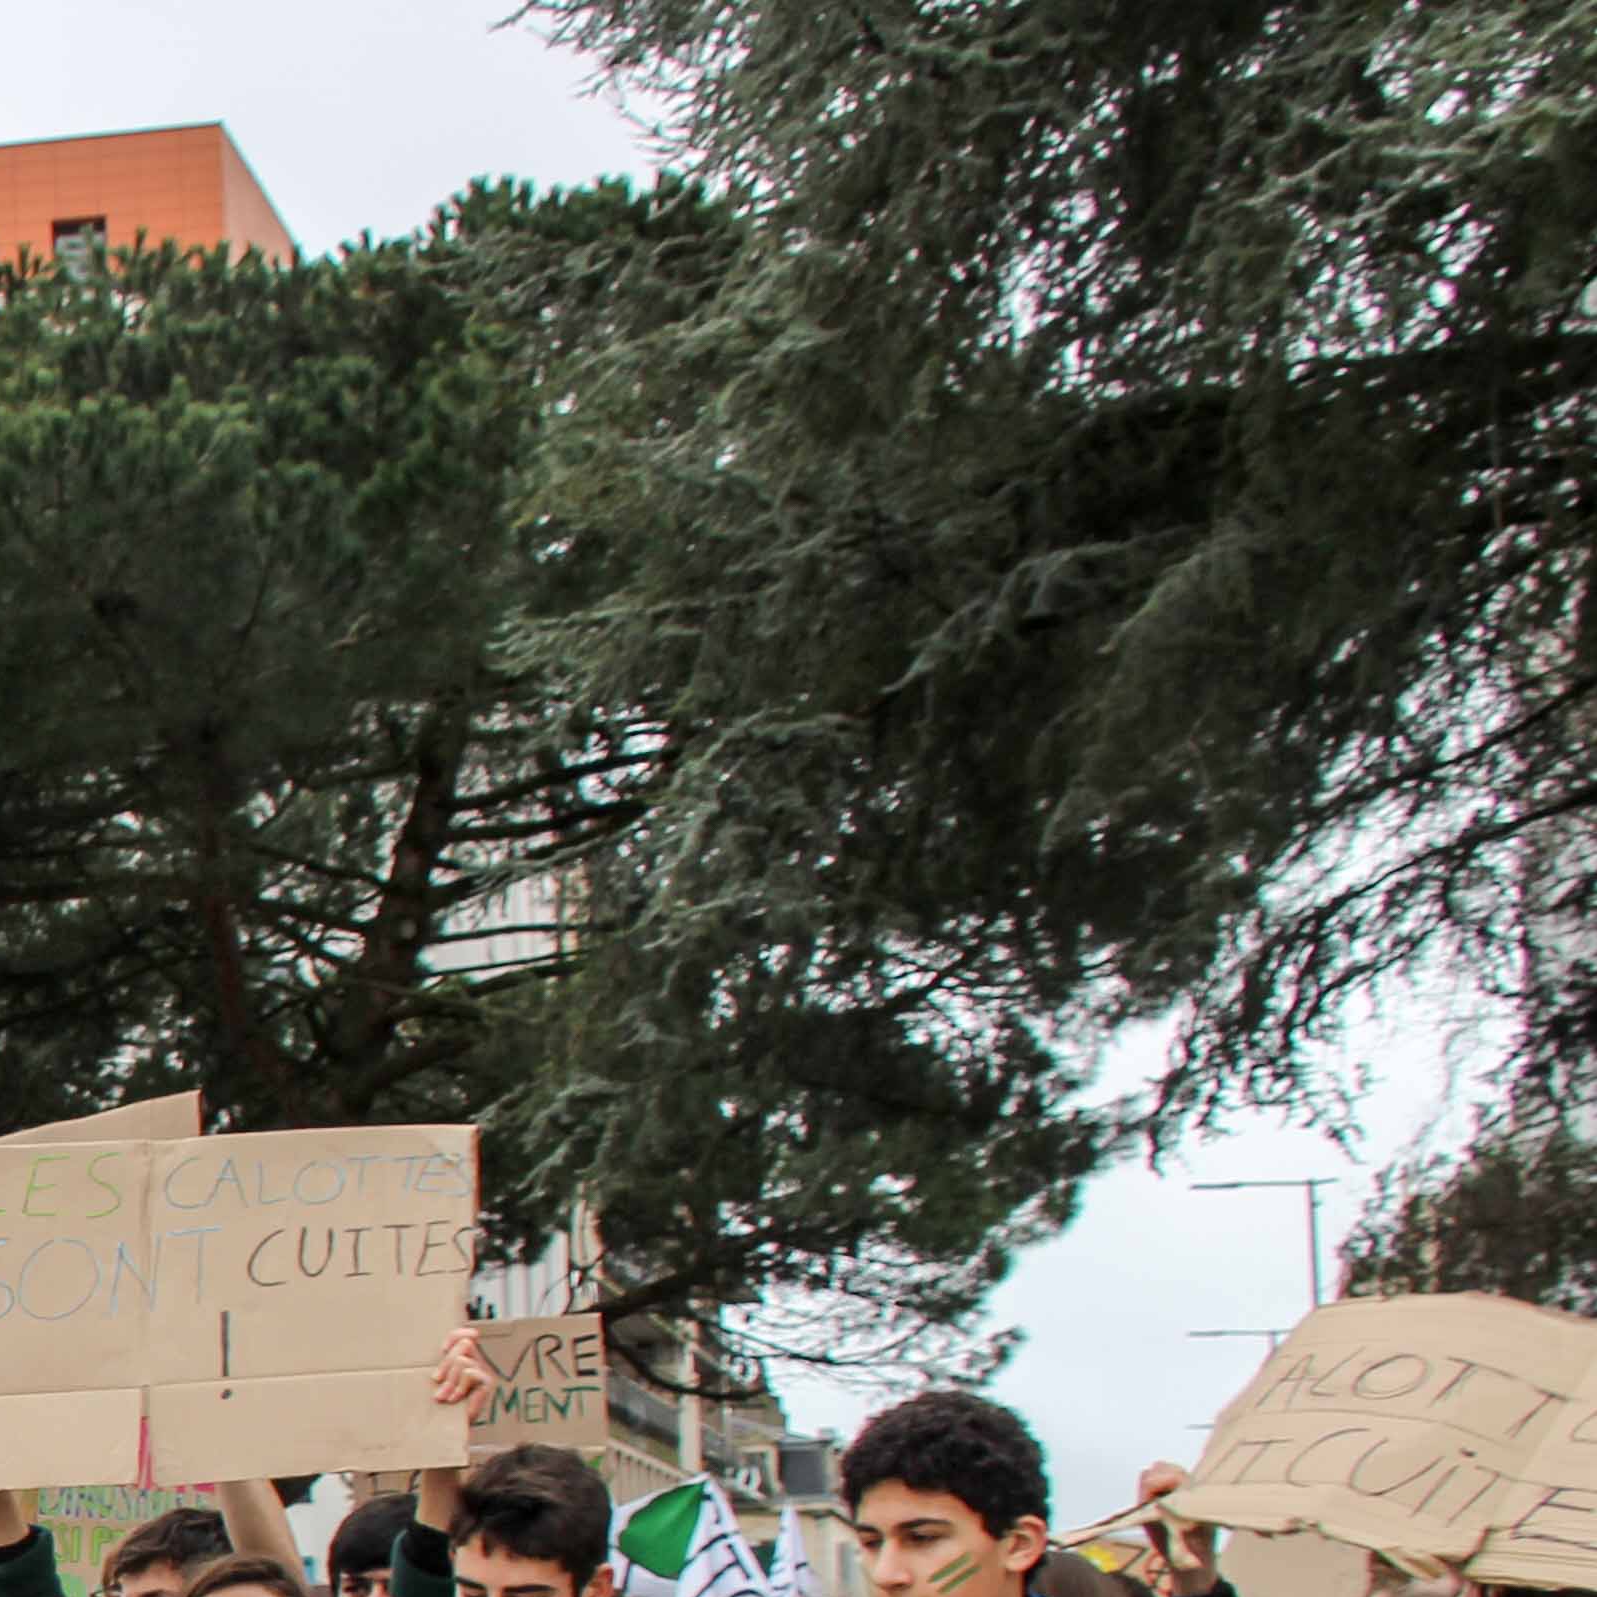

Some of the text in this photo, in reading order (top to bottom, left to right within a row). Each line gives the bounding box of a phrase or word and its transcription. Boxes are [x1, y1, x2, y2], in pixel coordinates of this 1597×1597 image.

[164, 1153, 472, 1209] CALOTTES
[246, 1220, 476, 1287] CUITES
[475, 1333, 598, 1381] VRE
[470, 1386, 601, 1427] MENT
